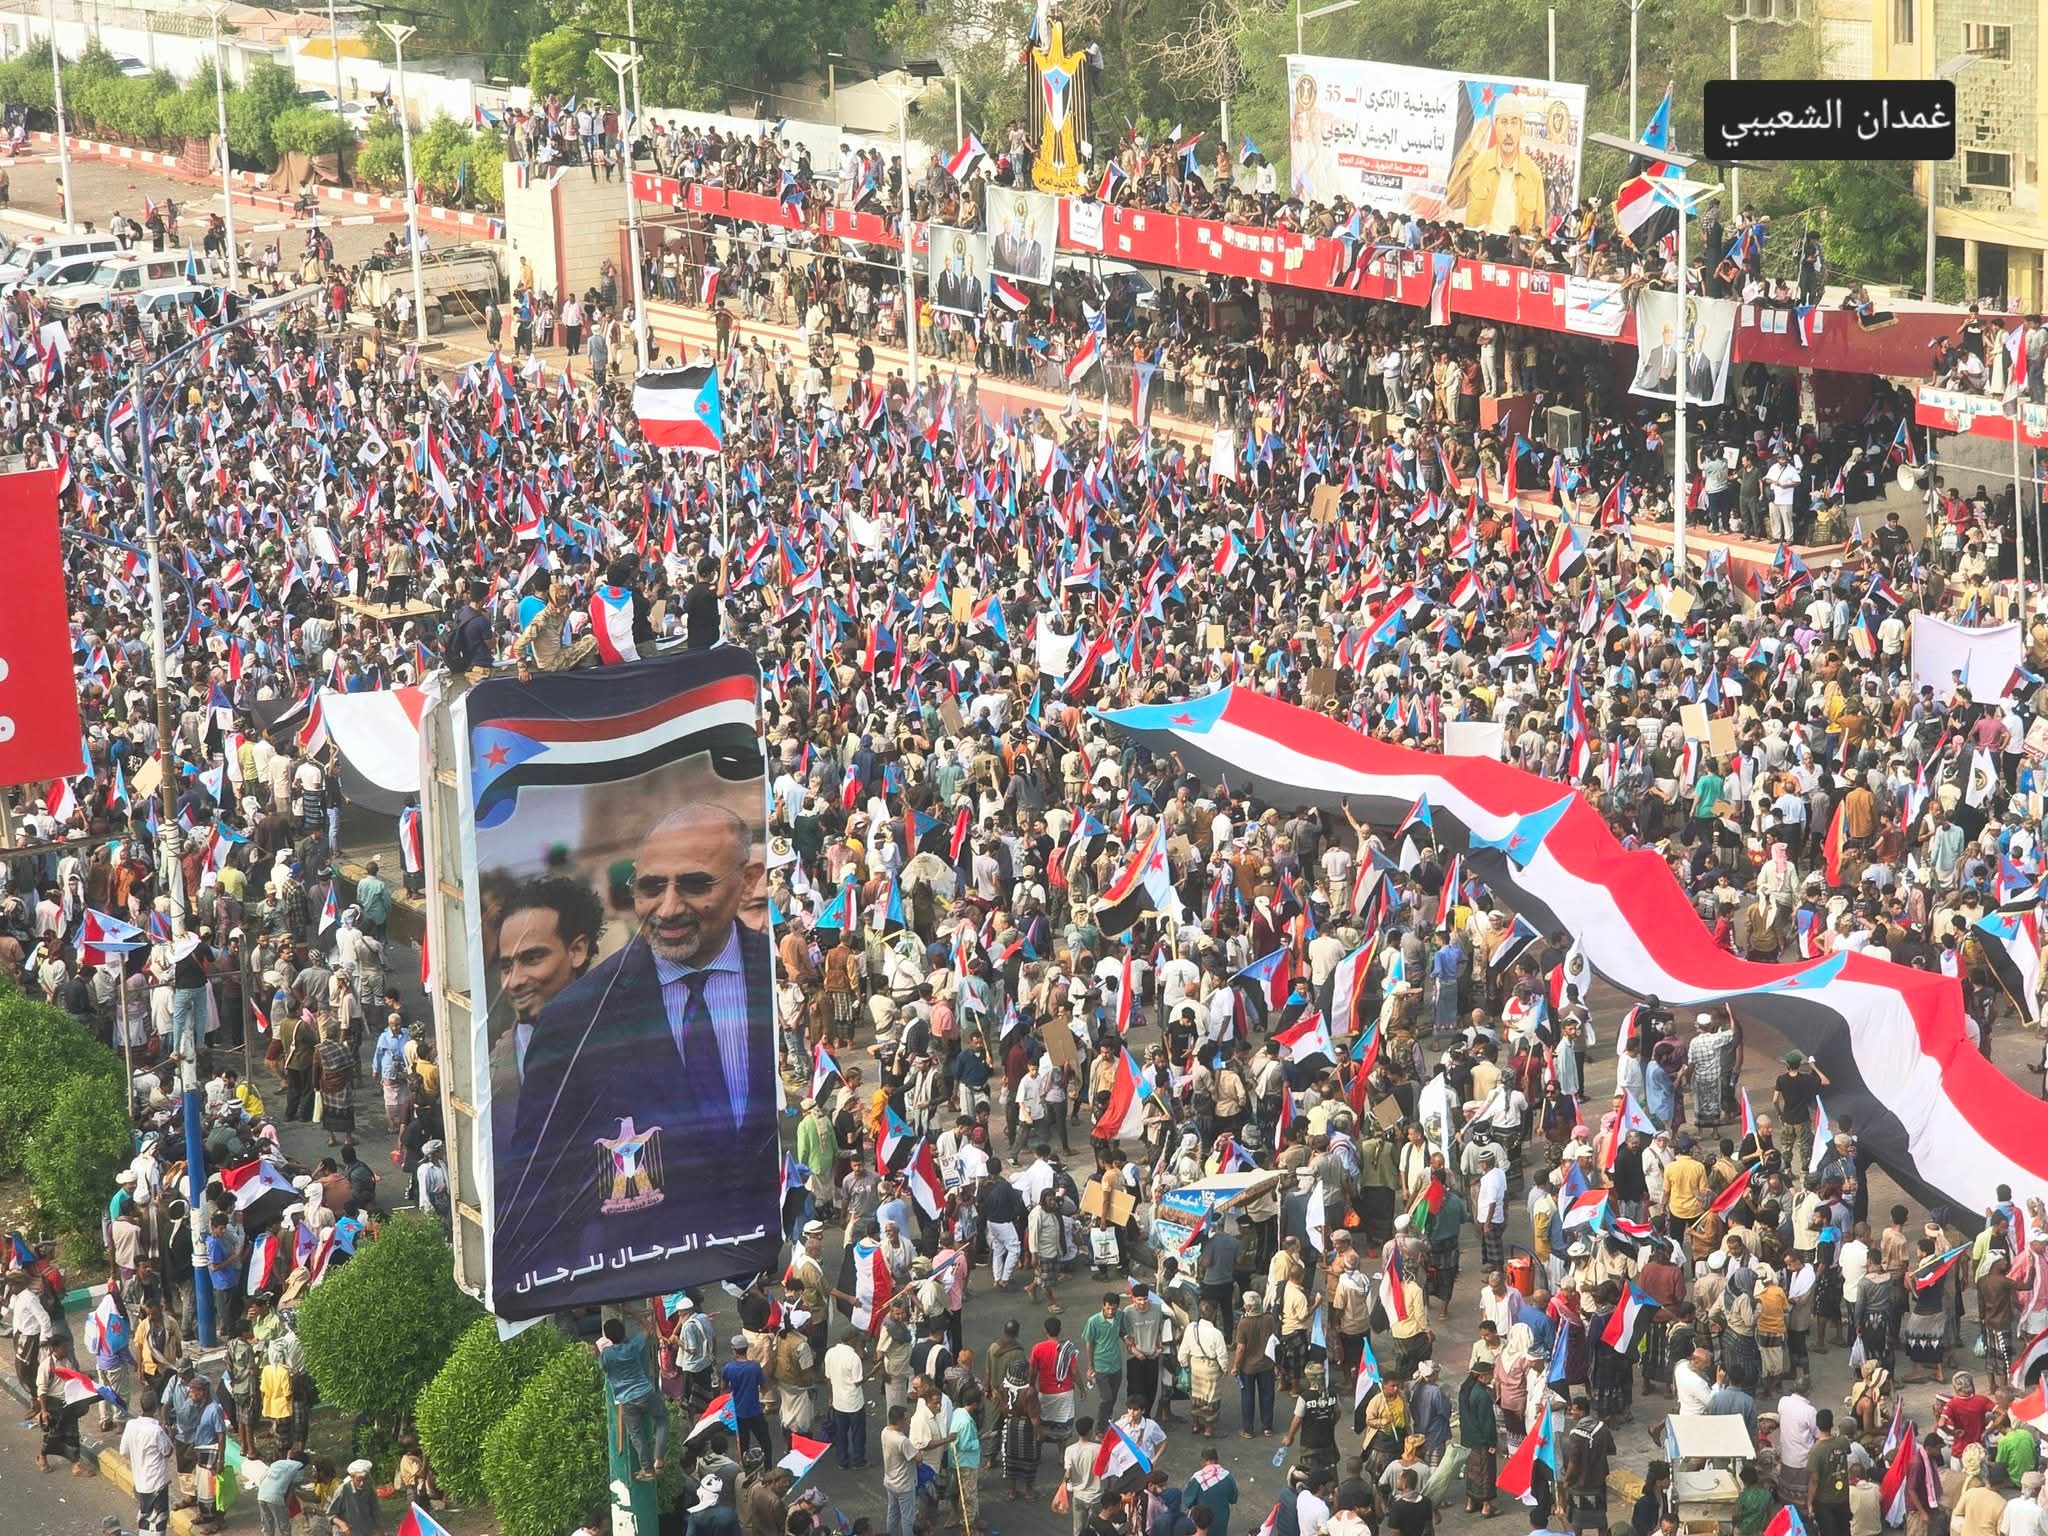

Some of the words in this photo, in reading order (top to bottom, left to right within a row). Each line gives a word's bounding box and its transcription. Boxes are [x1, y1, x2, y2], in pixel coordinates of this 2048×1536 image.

[1365, 89, 1400, 112] الذكرى
[1403, 91, 1447, 119] مليونية
[1360, 124, 1398, 151] الجيش
[1400, 126, 1445, 154] لتأسيس
[704, 1224, 766, 1248] عهد
[611, 1232, 699, 1270] الرجال
[515, 1253, 604, 1294] للرجال
